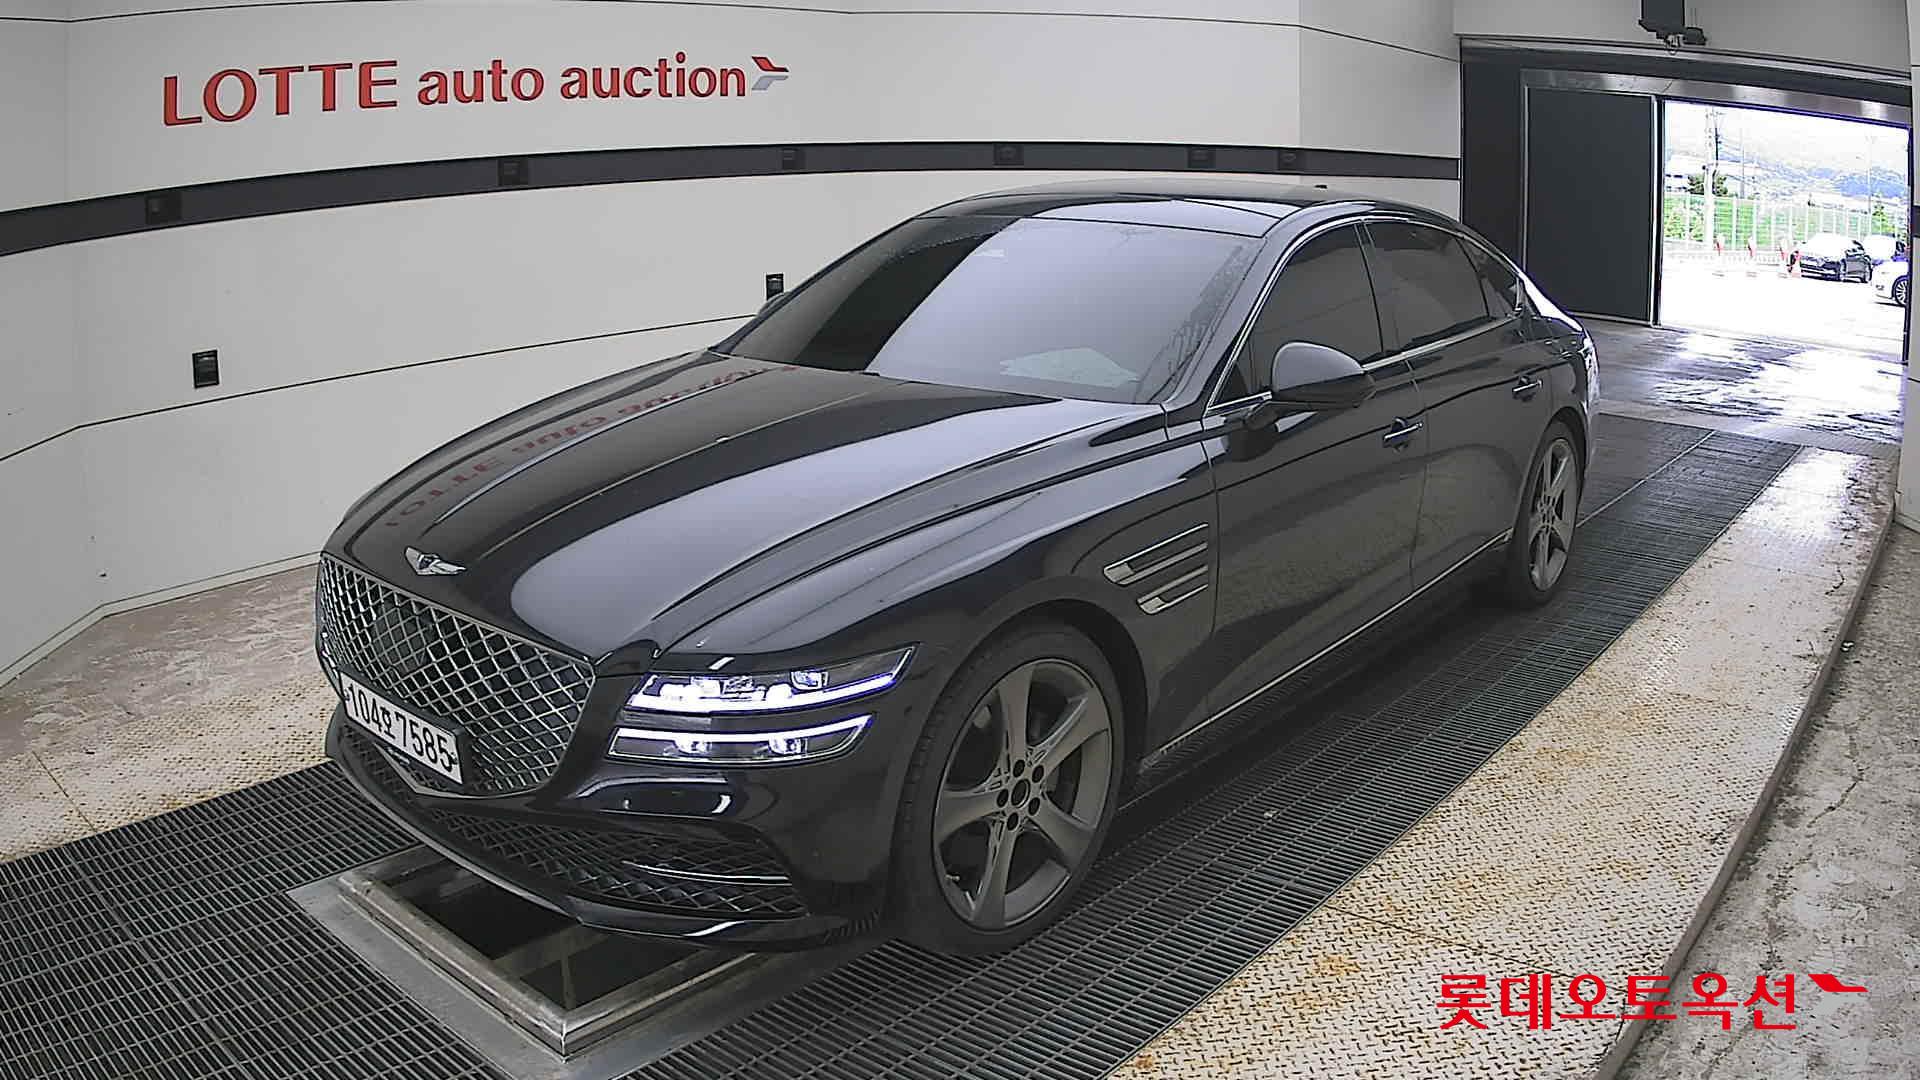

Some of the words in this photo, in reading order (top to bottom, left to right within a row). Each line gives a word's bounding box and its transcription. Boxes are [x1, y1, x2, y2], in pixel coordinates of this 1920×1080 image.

[162, 59, 399, 127] LOTTE
[416, 58, 545, 106] auto
[559, 50, 748, 100] auction
[396, 711, 454, 773] 7585
